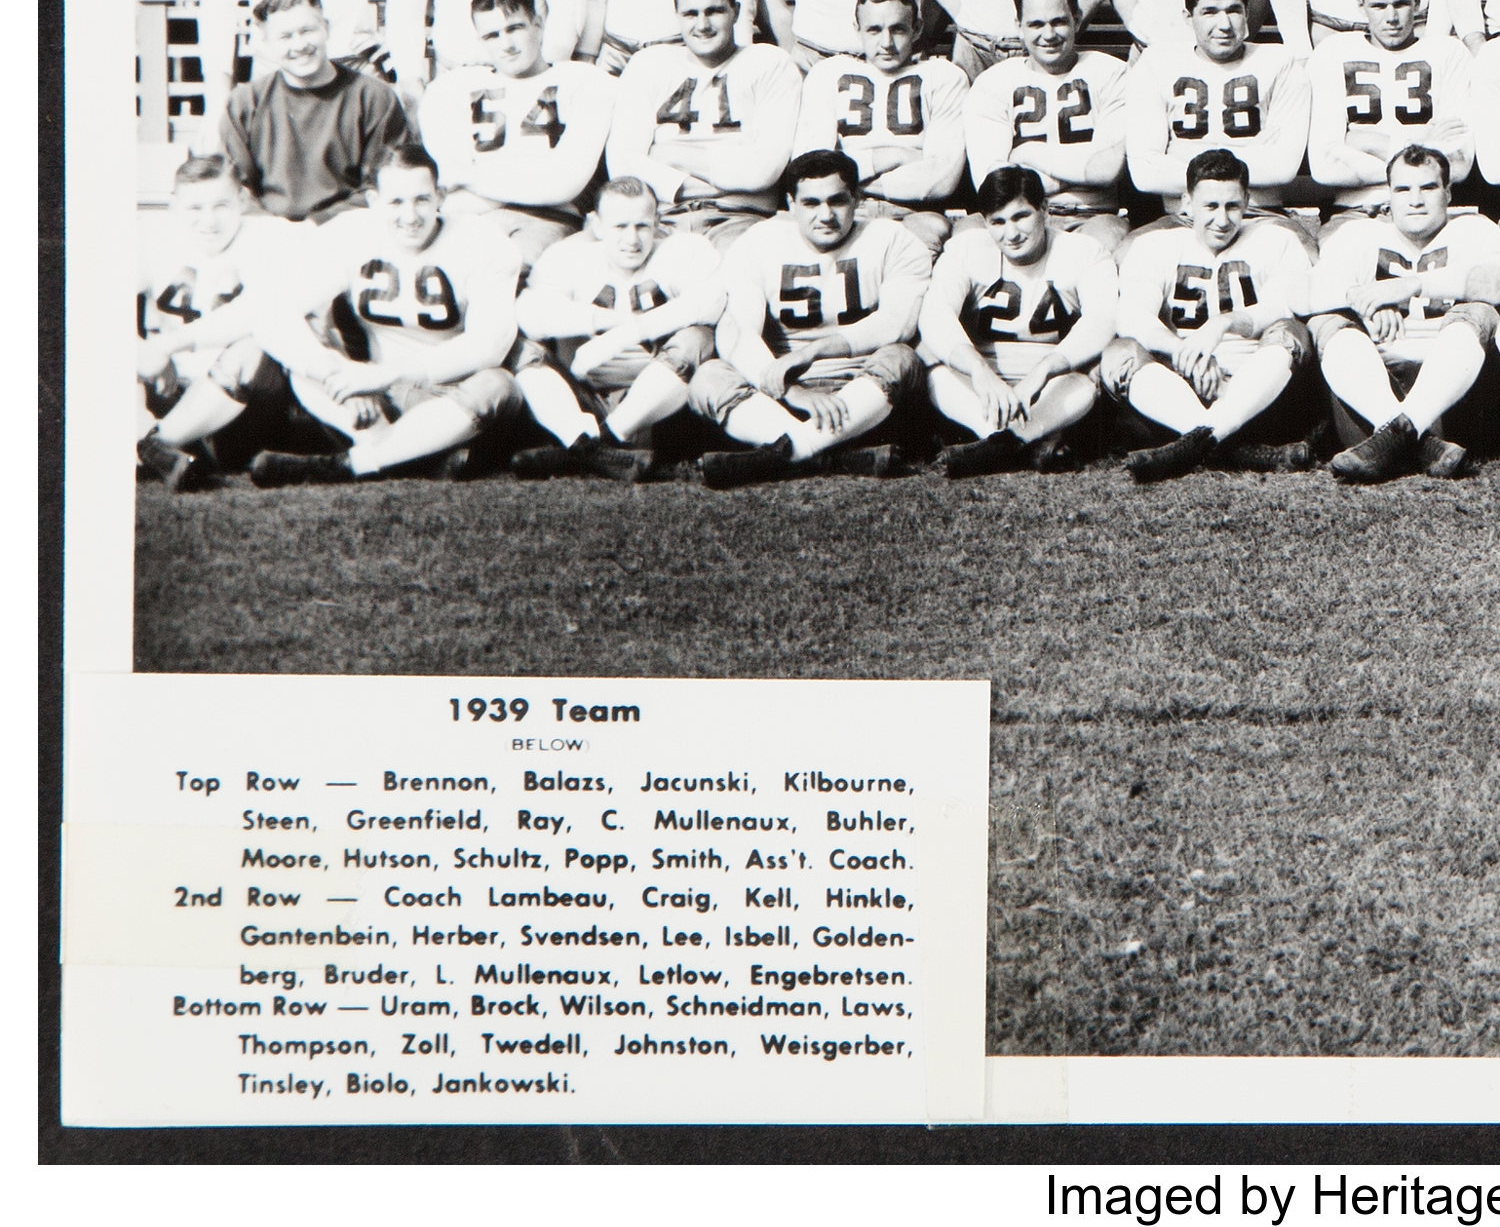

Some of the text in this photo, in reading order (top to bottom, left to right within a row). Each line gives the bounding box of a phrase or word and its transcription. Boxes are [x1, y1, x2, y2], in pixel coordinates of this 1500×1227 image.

[656, 76, 742, 133] 41
[837, 74, 923, 136] 30
[1012, 78, 1094, 144] 22
[1172, 76, 1262, 139] 38
[1343, 61, 1433, 124] 53
[471, 85, 566, 153] 54
[359, 258, 461, 330] 29
[779, 257, 870, 330] 51
[976, 279, 1082, 342] 24
[1173, 260, 1256, 329] 50
[450, 698, 640, 722] 1939 Team
[176, 772, 219, 796] Top
[247, 772, 299, 791] Row
[384, 771, 495, 793] Brennon,
[524, 771, 612, 794] Balazs,
[641, 772, 756, 794] Jacunski,
[785, 771, 914, 795] Kilbourne,
[243, 809, 914, 835] Steen, Greenfield, Ray, C. Mullenaux, Buhler,
[242, 848, 914, 873] Moore, Hutson, Schultz, Popp, Smith, Ass't. Coach.
[175, 886, 221, 907] 2nd
[248, 887, 300, 906] Row
[385, 886, 461, 907] Coach
[489, 886, 613, 910] Lambeau,
[642, 887, 717, 913] Craig,
[746, 887, 798, 910] Kell,
[827, 888, 913, 911] Hinkle,
[241, 925, 914, 949] Gantenbein, Herber, Svendsen, Lee, Isbell, Golden-
[241, 964, 912, 991] berg, Bruder, L. Mullenaux, Letlow, Engebretsen.
[274, 996, 326, 1015] Row
[382, 996, 457, 1018] Uram,
[472, 994, 546, 1018] Brock,
[560, 995, 652, 1018] Wilson,
[667, 995, 828, 1019] Schneidman,
[843, 997, 911, 1019] Laws,
[239, 1033, 912, 1061] Thompson, Zoll, Twedell, Johnston, Weisgerber,
[239, 1072, 575, 1099] Tinsley, Biolo, Jankowski.
